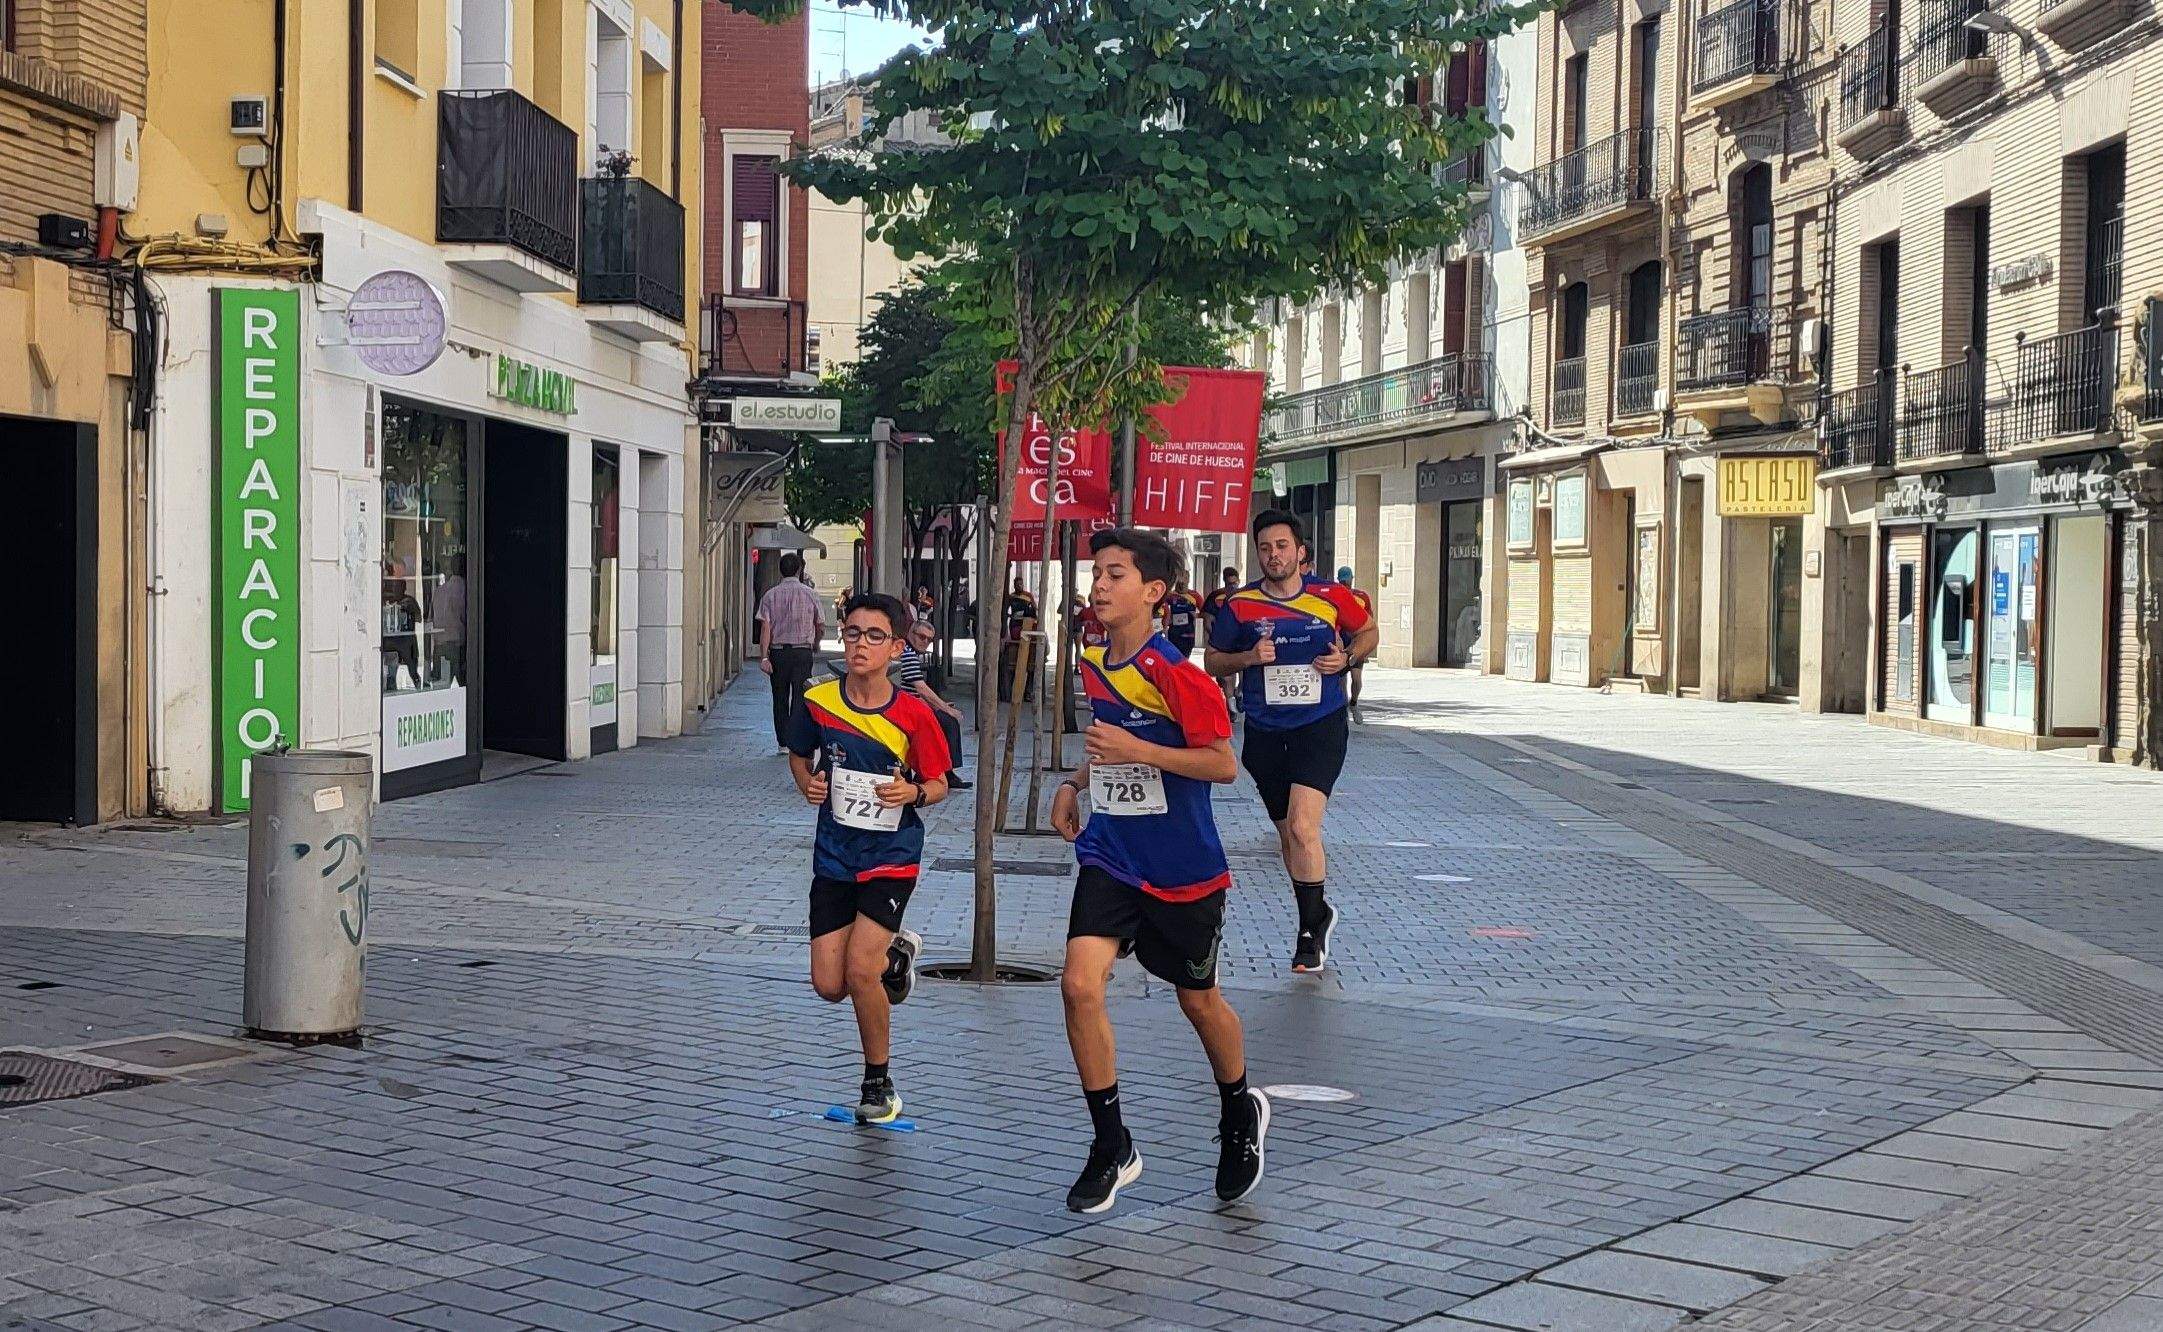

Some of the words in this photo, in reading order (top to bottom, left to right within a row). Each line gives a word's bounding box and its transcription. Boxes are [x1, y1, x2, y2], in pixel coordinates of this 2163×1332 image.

[741, 401, 836, 420] el.estudio
[1030, 436, 1076, 466] es
[1185, 442, 1246, 451] INTERNACIONAL
[1150, 452, 1164, 463] DE
[1165, 452, 1188, 465] CINE
[1189, 454, 1204, 466] DE
[1204, 456, 1245, 469] HUESCA
[1030, 478, 1078, 504] ca
[1725, 460, 1808, 503] ASCASO
[1145, 476, 1243, 516] HIFF
[1278, 684, 1311, 698] 392
[397, 707, 455, 748] REPARACIONES
[1102, 781, 1147, 803] 728
[844, 796, 884, 819] 727
